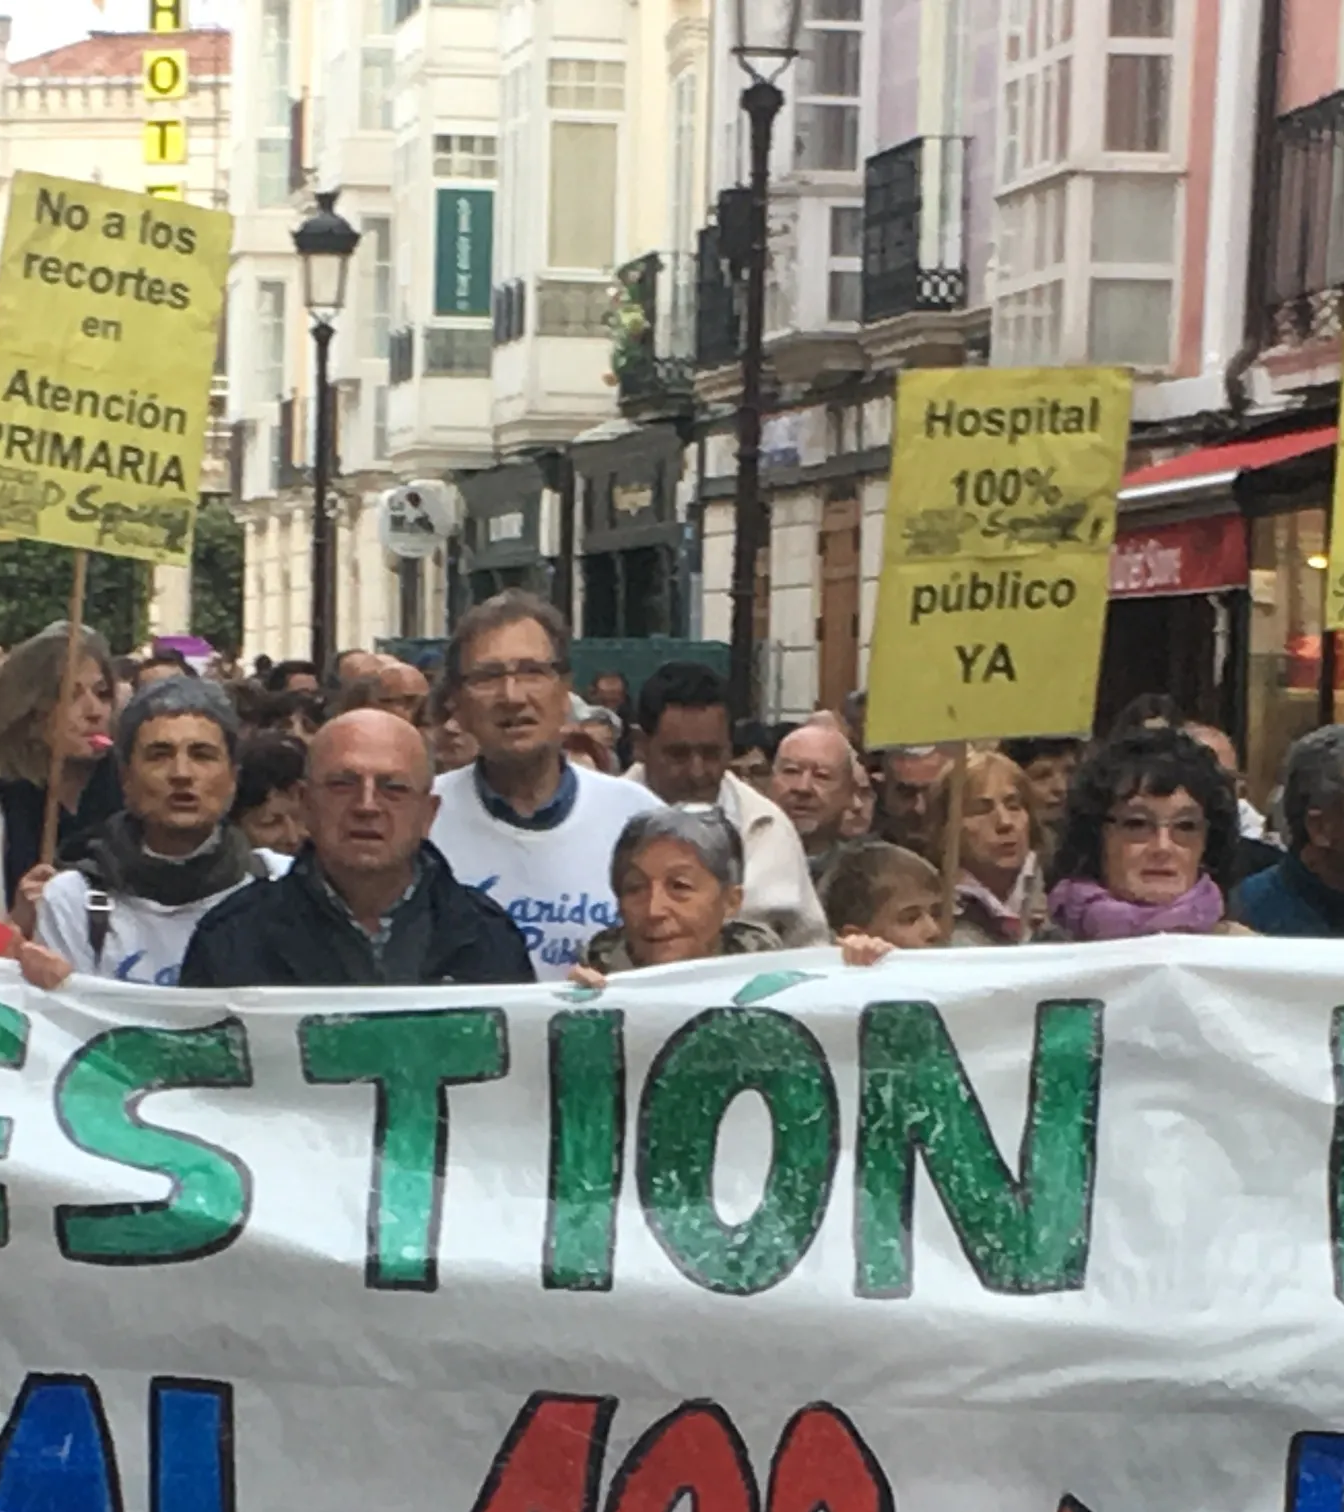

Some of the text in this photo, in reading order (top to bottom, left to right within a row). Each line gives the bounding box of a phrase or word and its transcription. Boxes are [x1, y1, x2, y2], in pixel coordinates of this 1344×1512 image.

[35, 187, 197, 255] No a los
[23, 251, 191, 311] recortes
[81, 315, 122, 342] en
[2, 369, 187, 435] Atención
[924, 396, 1102, 446] Hospital
[951, 465, 1063, 507] 100%
[910, 570, 1076, 626] público
[954, 642, 1017, 684] YA
